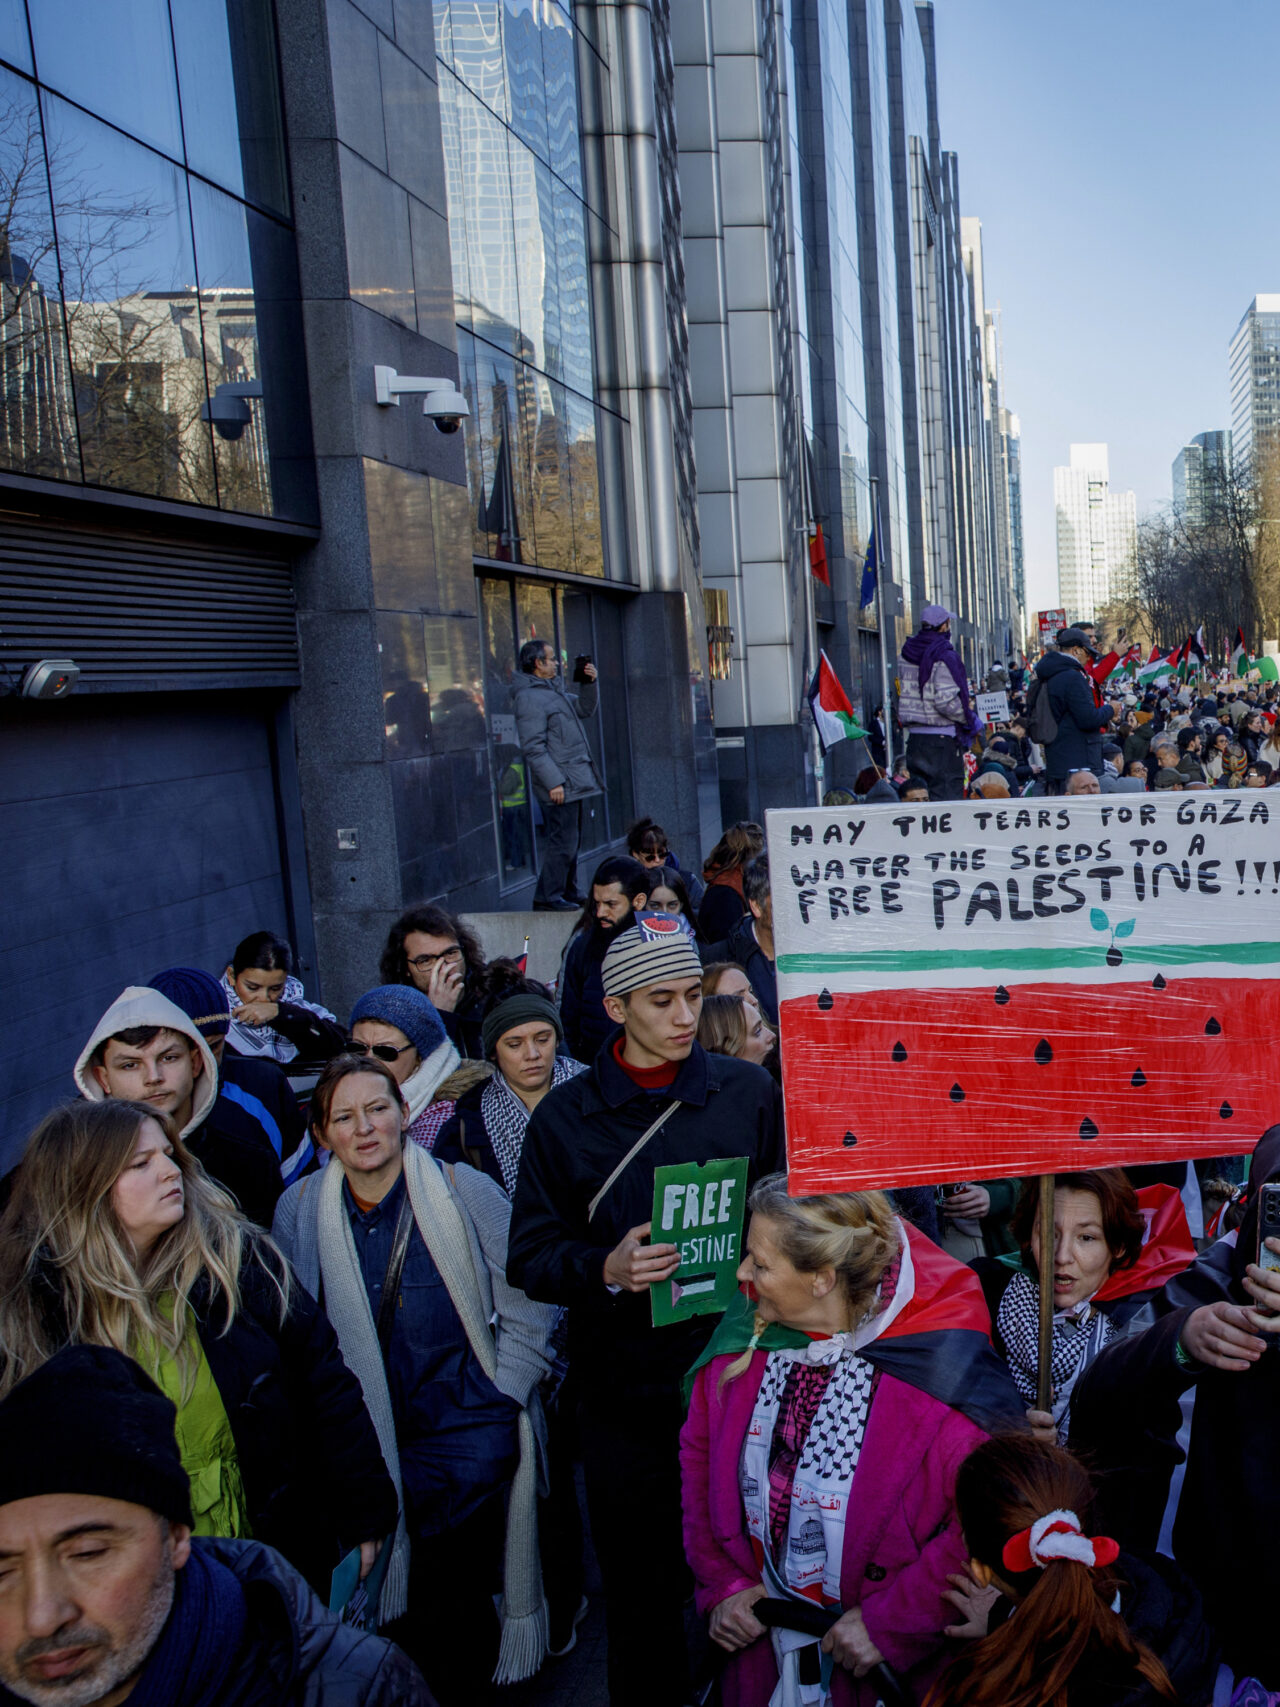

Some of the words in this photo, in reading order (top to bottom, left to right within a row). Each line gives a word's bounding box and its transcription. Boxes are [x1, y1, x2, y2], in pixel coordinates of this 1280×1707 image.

[791, 820, 866, 846] MAY
[892, 812, 953, 837] THE
[973, 809, 1070, 830] TEARS
[1100, 804, 1157, 826] FOR
[1177, 799, 1270, 825] GAZA
[791, 854, 910, 887] WATER
[924, 848, 987, 872] THE
[1010, 839, 1112, 870] SEEDS
[1129, 838, 1168, 857] TO
[1188, 834, 1205, 856] A
[798, 881, 903, 924] FREE
[661, 1178, 736, 1230] FREE
[675, 1233, 736, 1265] ESTINE
